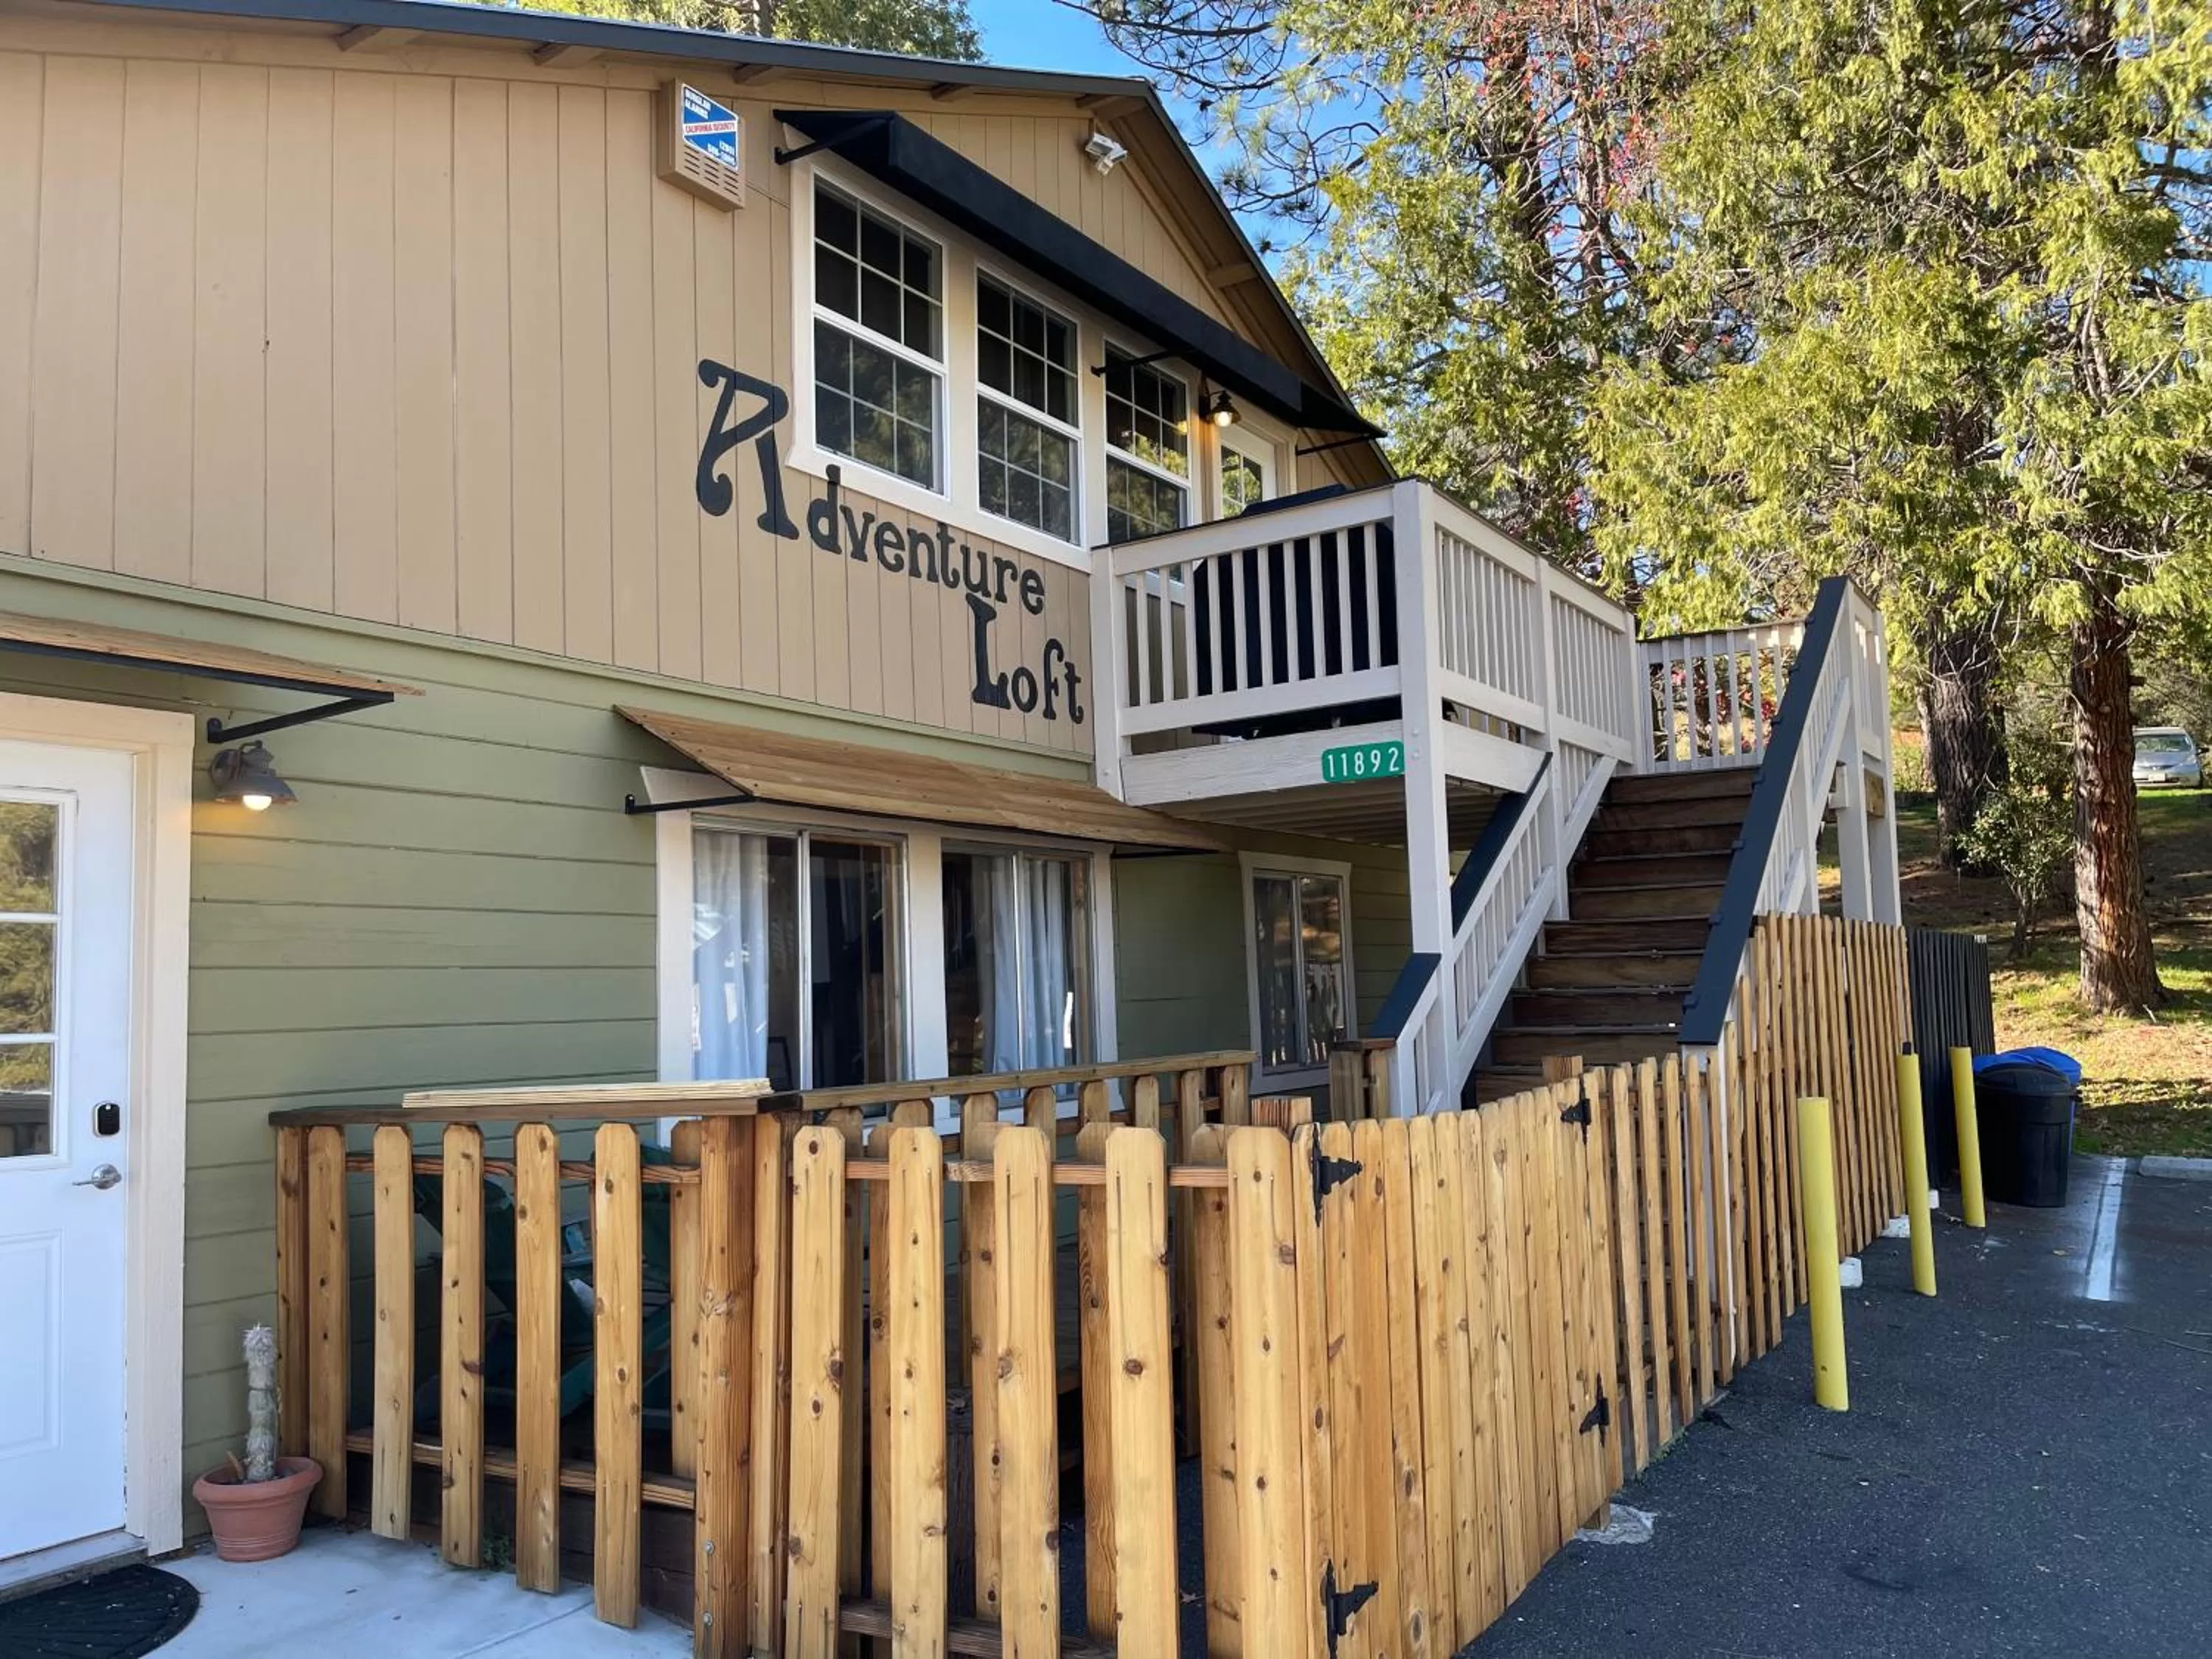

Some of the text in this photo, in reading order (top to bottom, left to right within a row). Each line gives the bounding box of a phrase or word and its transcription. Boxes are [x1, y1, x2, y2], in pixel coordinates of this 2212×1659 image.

[697, 359, 1045, 614] Adventure
[966, 593, 1083, 724] Loft
[1327, 747, 1399, 778] 11892
